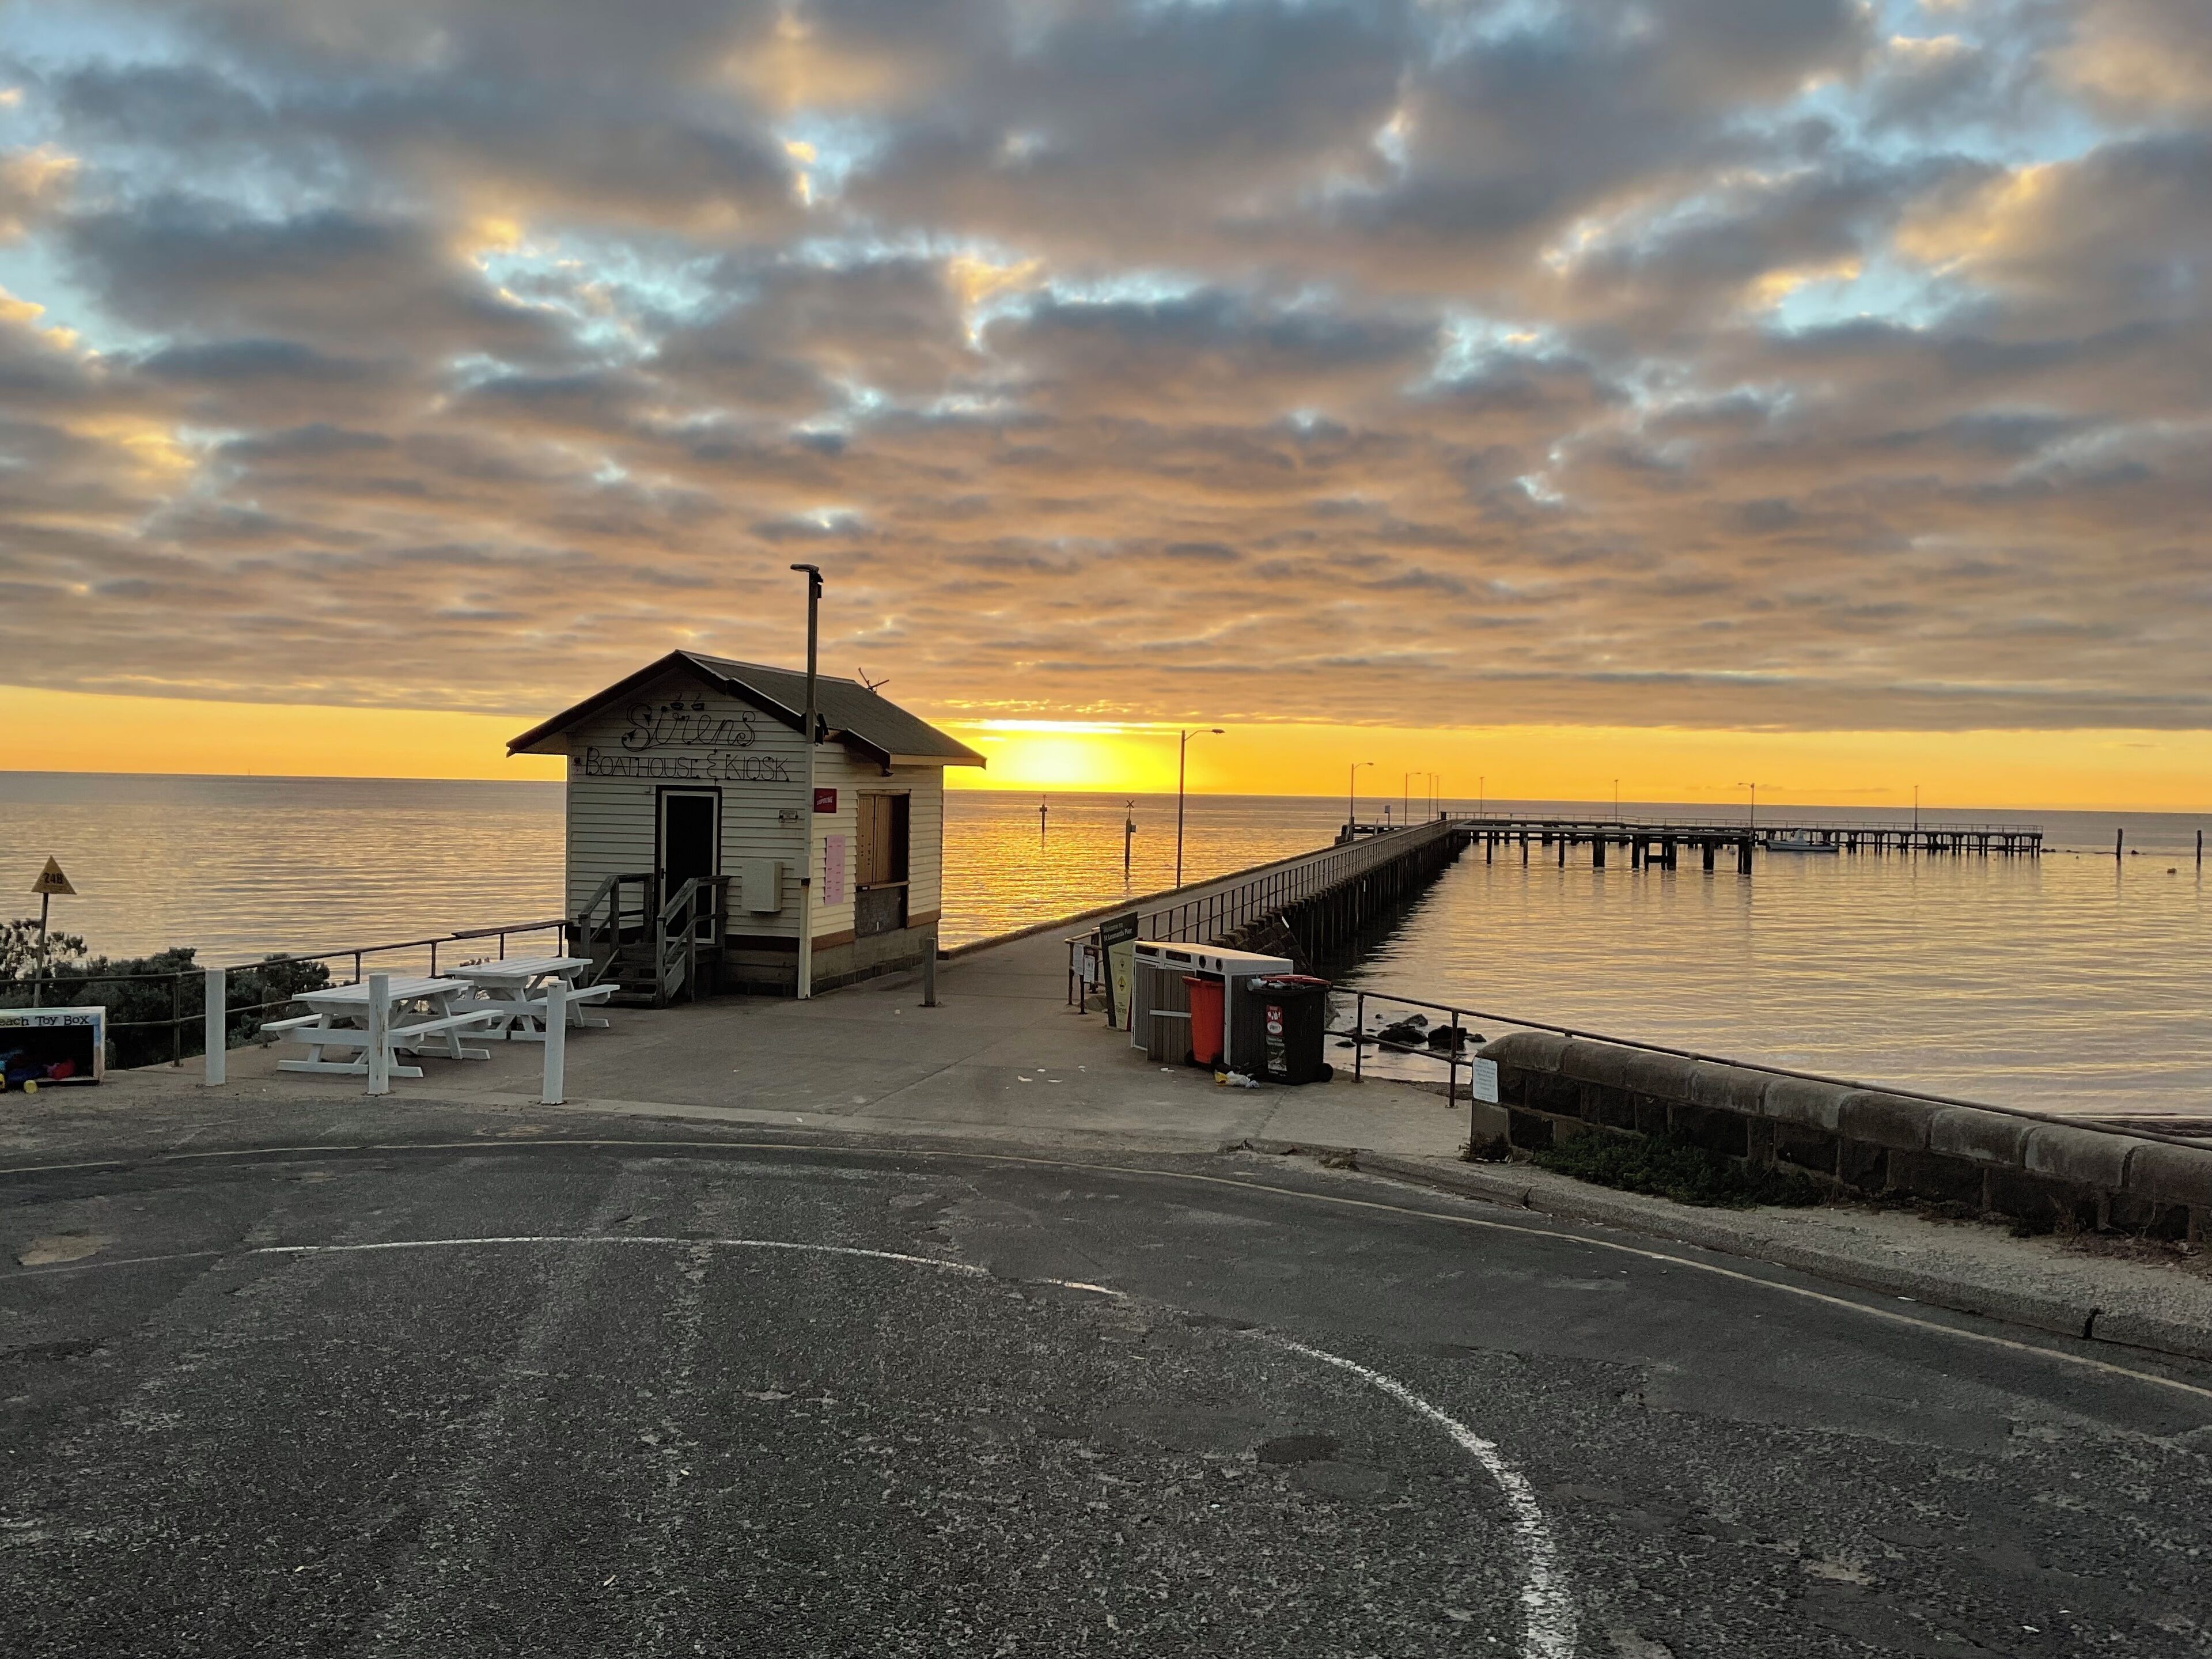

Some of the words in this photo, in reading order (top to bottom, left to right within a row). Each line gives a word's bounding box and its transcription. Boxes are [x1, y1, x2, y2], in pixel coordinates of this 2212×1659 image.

[622, 702, 756, 752] Sirens
[724, 753, 790, 782] KIOSK
[1124, 927, 1132, 936] Pier
[0, 1016, 29, 1027] each
